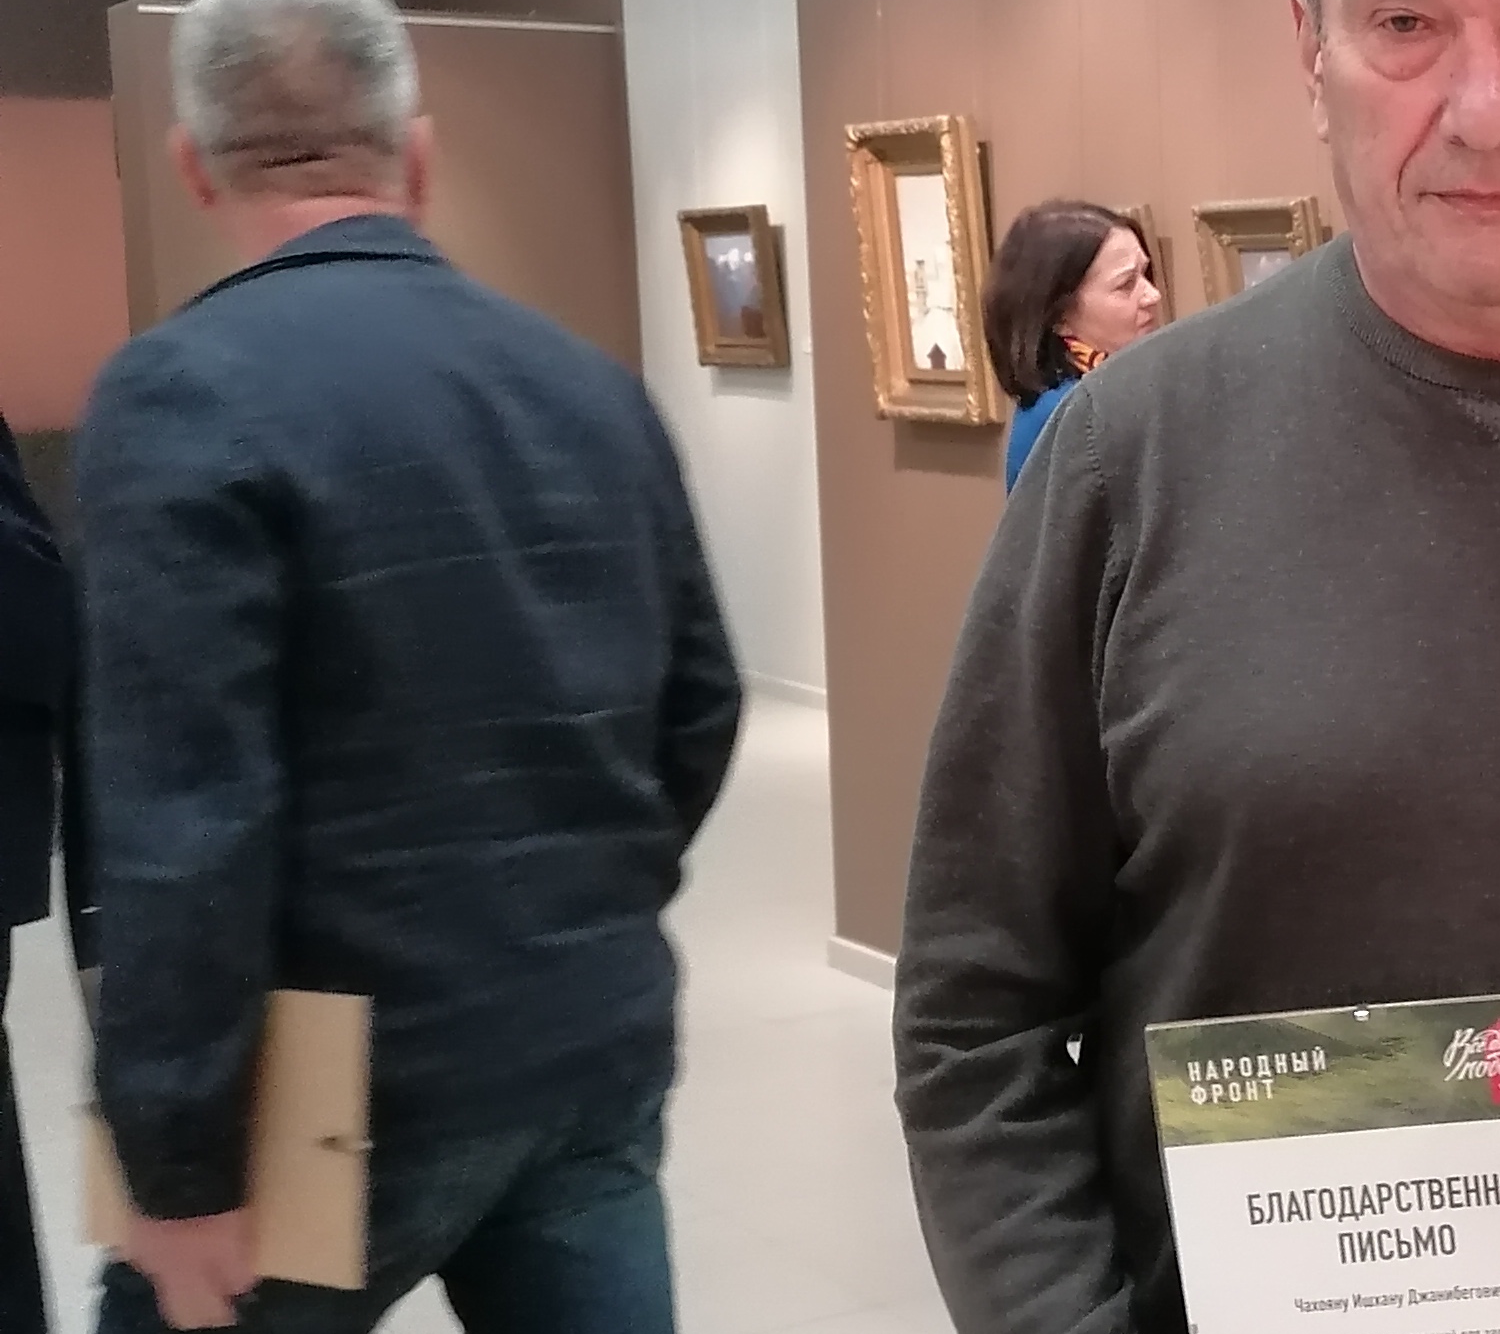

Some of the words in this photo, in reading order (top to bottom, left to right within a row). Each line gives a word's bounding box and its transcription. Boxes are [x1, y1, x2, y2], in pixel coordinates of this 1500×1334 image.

[1187, 1046, 1327, 1081] НАРОДНЫЙ
[1190, 1079, 1275, 1106] ФРОНТ
[1338, 1223, 1457, 1264] ПИСЬМО
